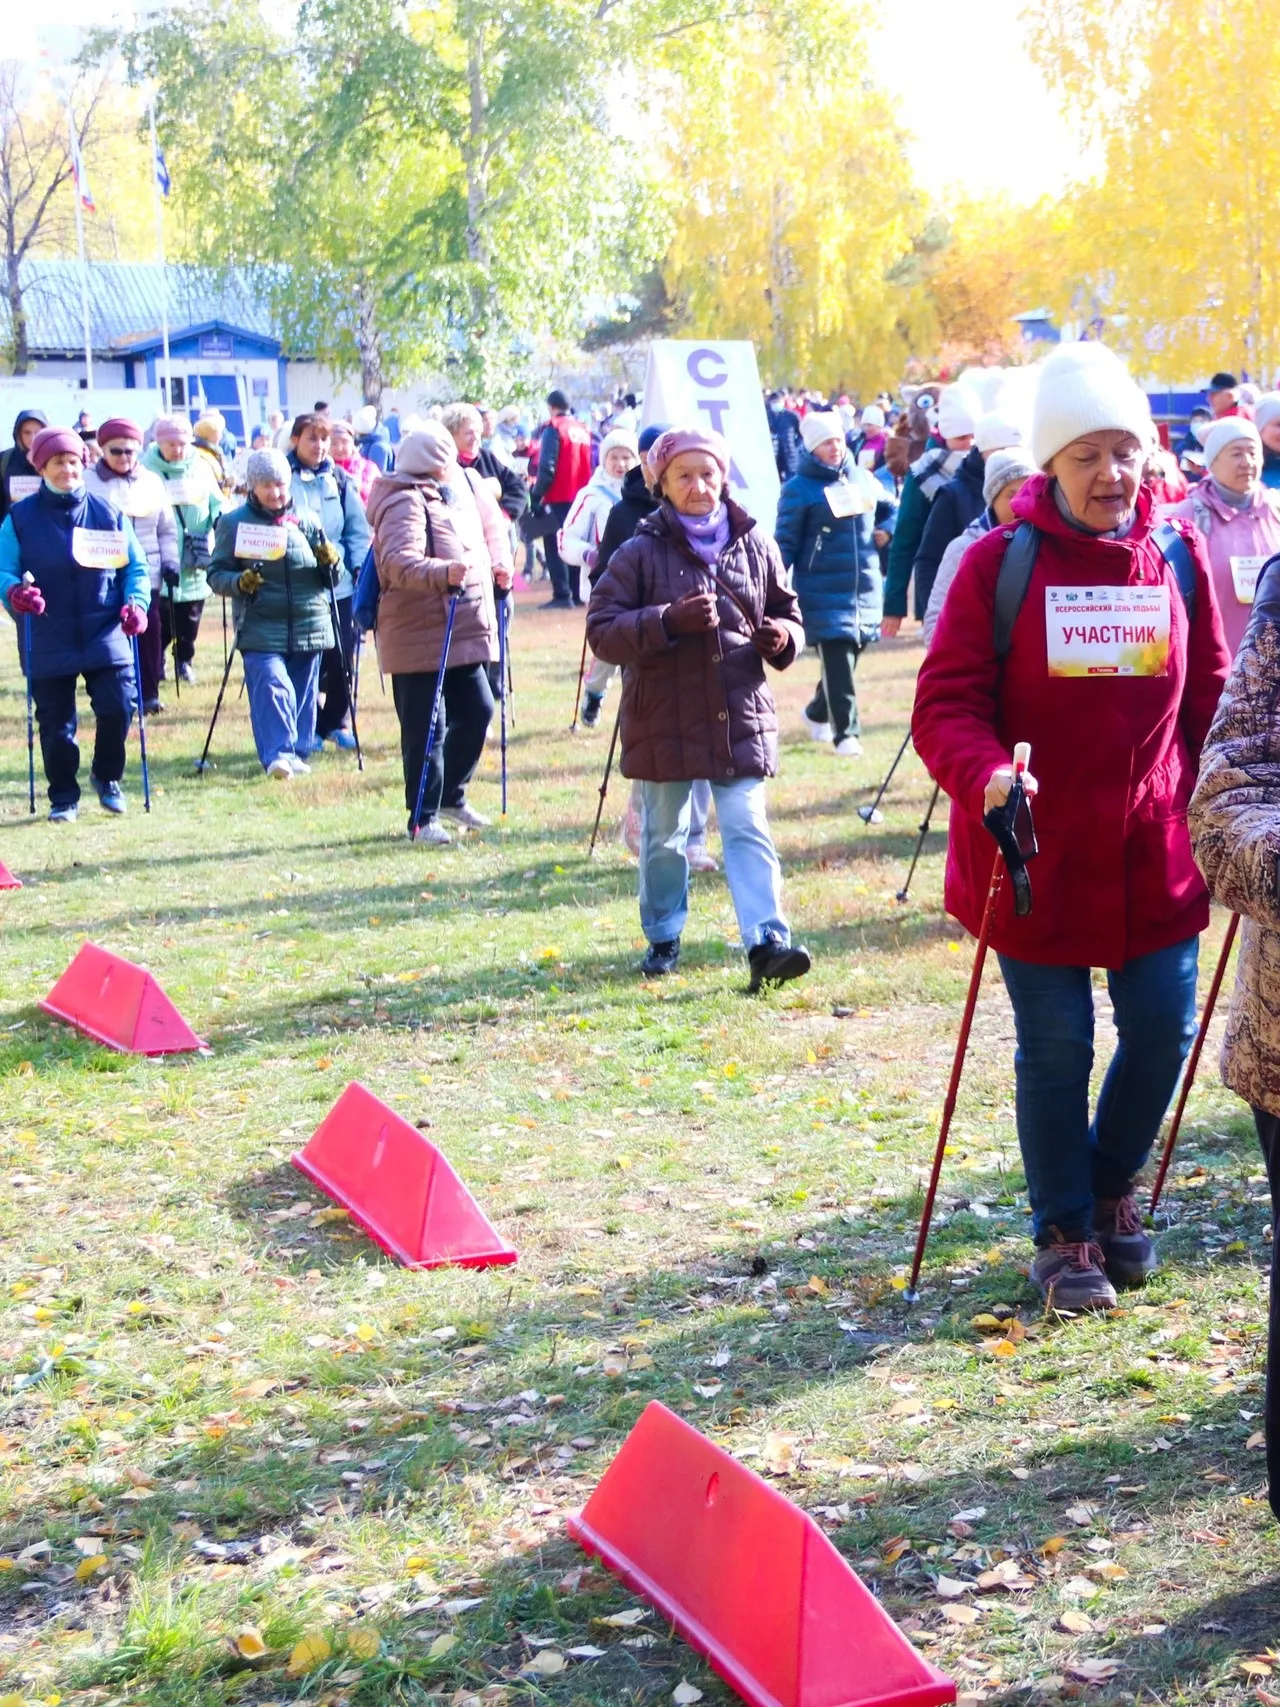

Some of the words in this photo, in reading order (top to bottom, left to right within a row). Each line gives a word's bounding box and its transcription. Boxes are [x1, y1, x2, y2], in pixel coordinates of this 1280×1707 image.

[1055, 603, 1112, 613] ВСЕРОССИЙСКИЙ
[1114, 605, 1131, 613] ДЕНЬ
[1132, 605, 1161, 613] ХОДЬБЫ
[1062, 625, 1156, 644] УЧАСТНИК
